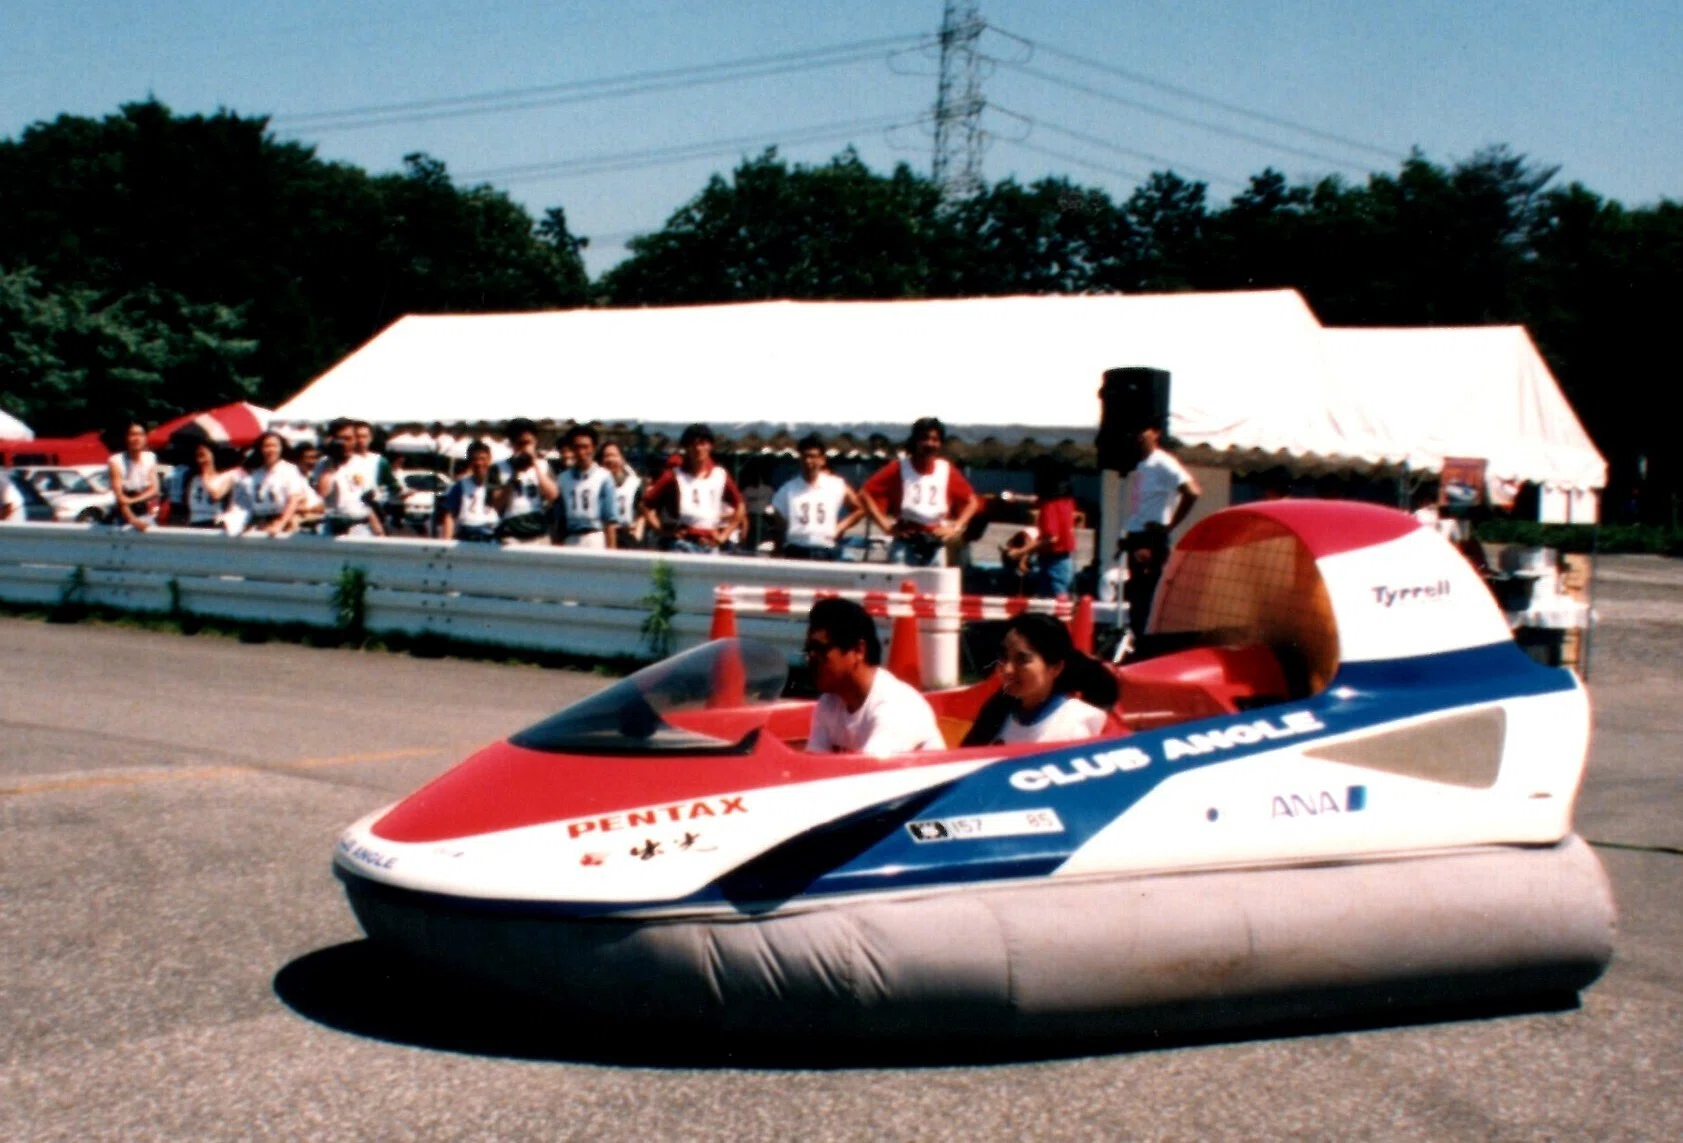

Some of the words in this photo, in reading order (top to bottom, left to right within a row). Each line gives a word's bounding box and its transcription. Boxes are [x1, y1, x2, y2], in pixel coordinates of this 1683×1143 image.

[797, 501, 827, 526] 35
[1371, 579, 1450, 608] Tyrrell
[1009, 747, 1152, 791] CLUB
[1161, 710, 1326, 761] ANGLE
[567, 796, 748, 839] PENTAX
[1271, 790, 1341, 819] ANA
